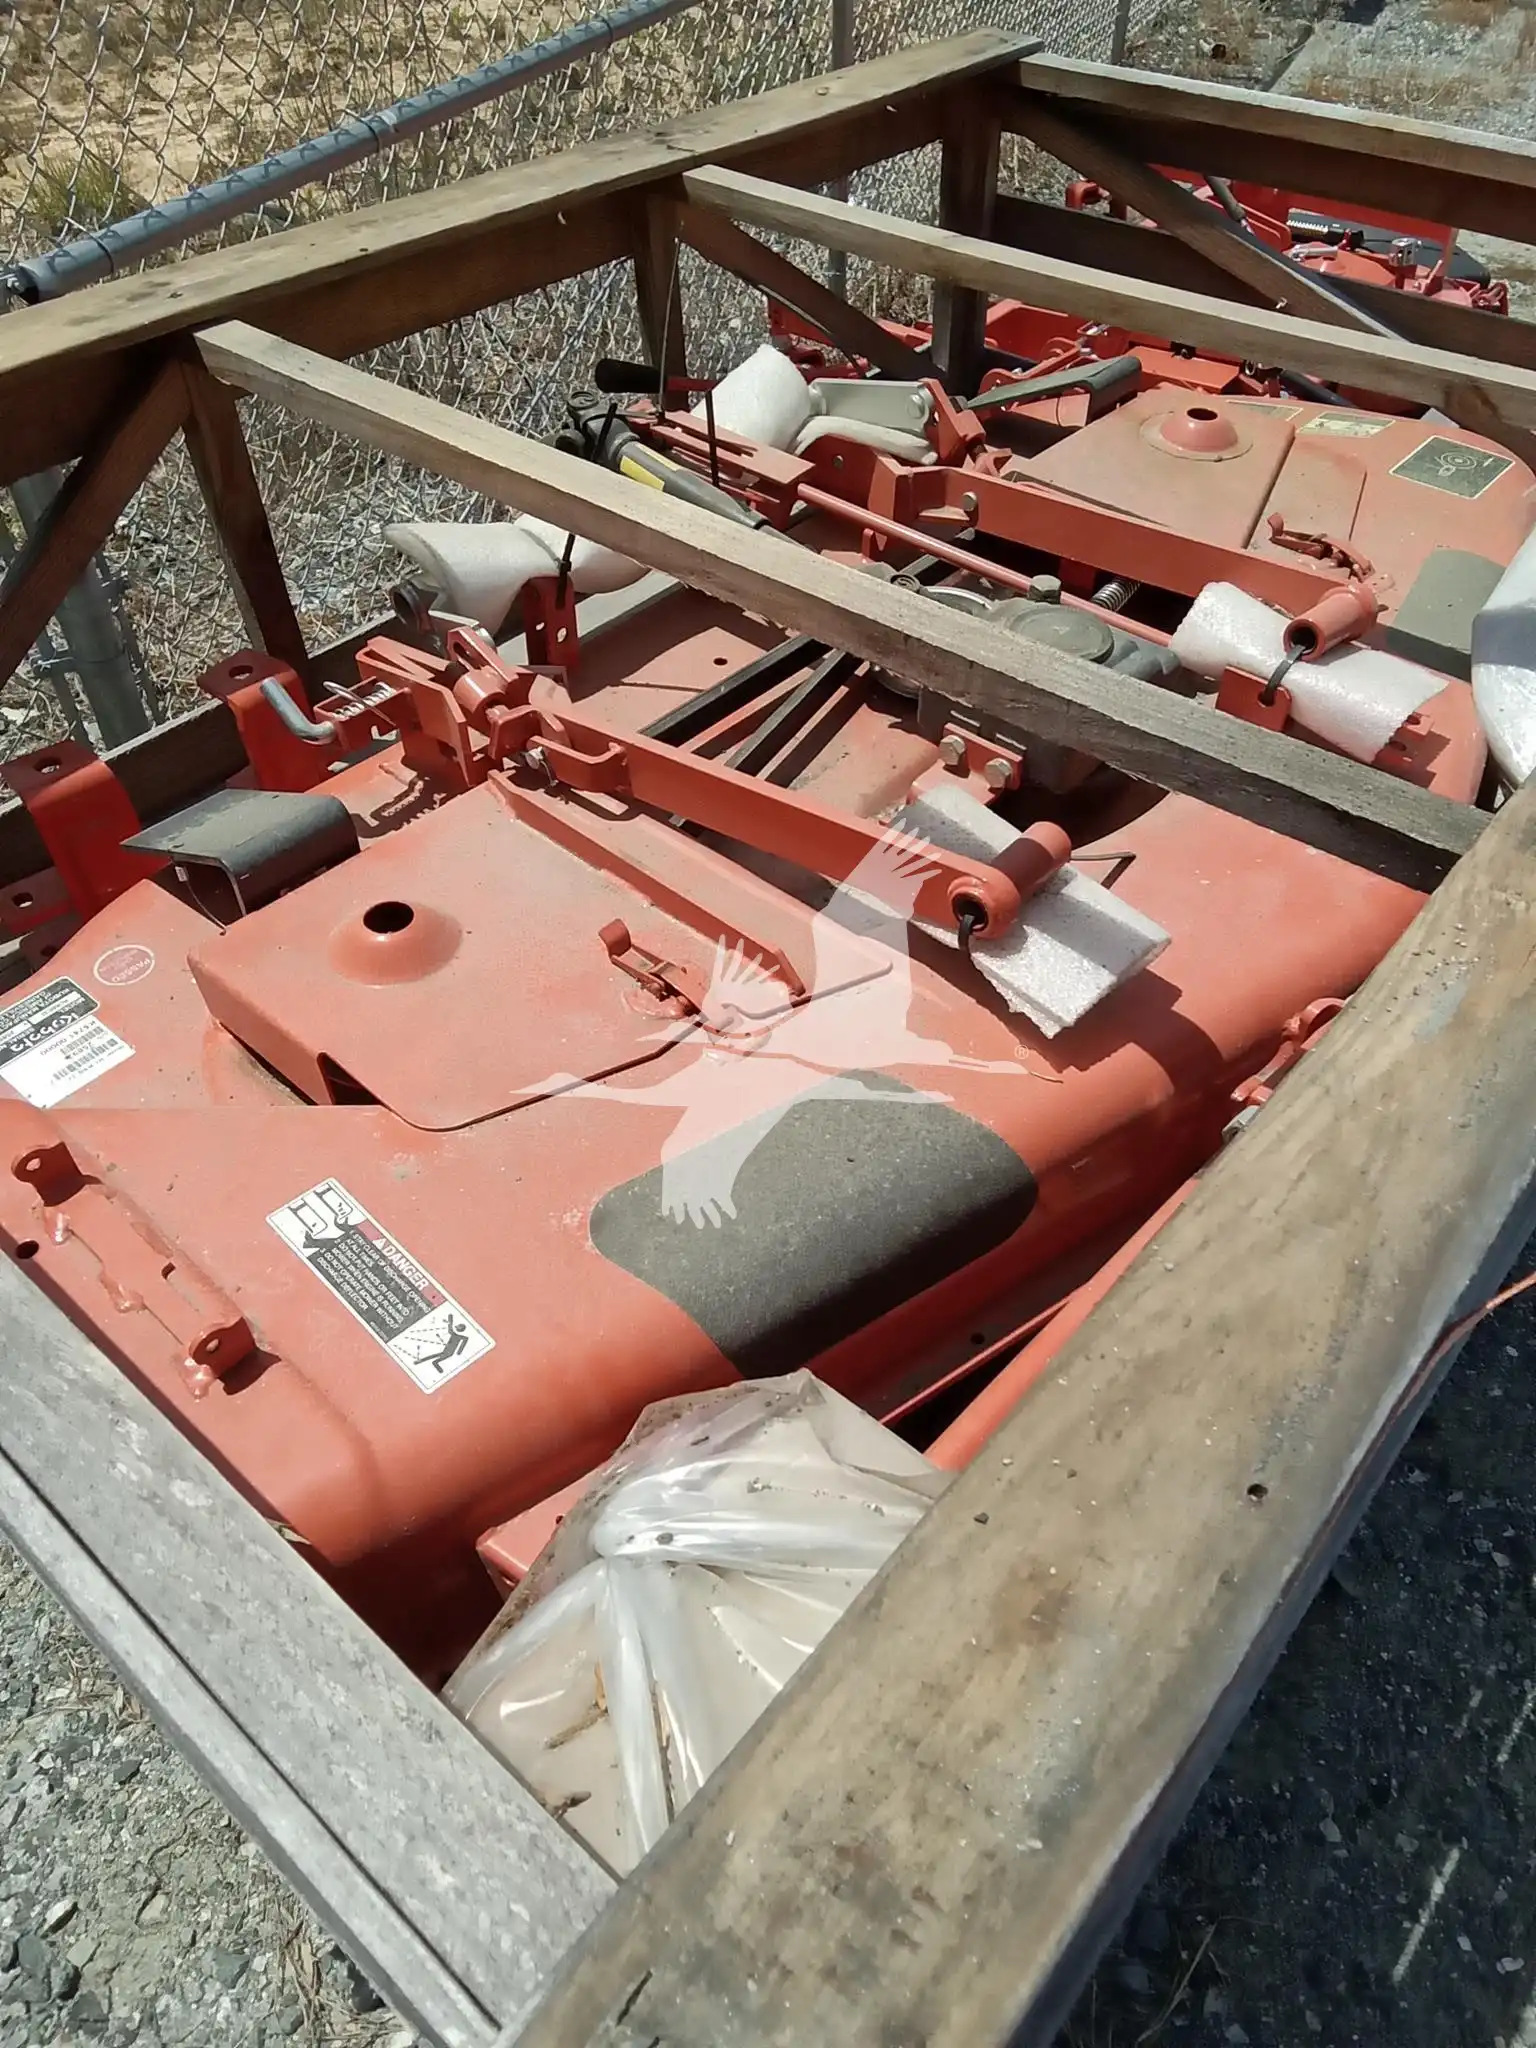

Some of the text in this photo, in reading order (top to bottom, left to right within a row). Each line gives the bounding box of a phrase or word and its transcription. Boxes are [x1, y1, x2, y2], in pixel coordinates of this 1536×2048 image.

[37, 987, 70, 1008] KUBOTA
[59, 996, 85, 1013] MODEL
[7, 1026, 35, 1043] SERIAL
[8, 1010, 80, 1054] Kubota
[316, 1255, 344, 1284] DISCHARGE
[349, 1242, 362, 1254] ALL
[381, 1244, 429, 1291] DANGER
[330, 1246, 351, 1266] MOWER
[346, 1263, 364, 1280] WHEN
[359, 1277, 380, 1297] ENGINE
[344, 1248, 358, 1261] NOT
[353, 1258, 367, 1270] PUT
[362, 1267, 381, 1285] HANDS
[383, 1290, 400, 1305] FEET
[394, 1301, 411, 1317] INTO
[352, 1232, 367, 1246] STAY
[362, 1243, 381, 1261] CLEAR
[382, 1264, 411, 1293] DISCHARGE
[406, 1289, 431, 1313] OPENING
[329, 1258, 343, 1271] NOT
[338, 1268, 362, 1291] OPERATE
[358, 1288, 379, 1309] MOWER
[374, 1306, 399, 1330] WITHOUT
